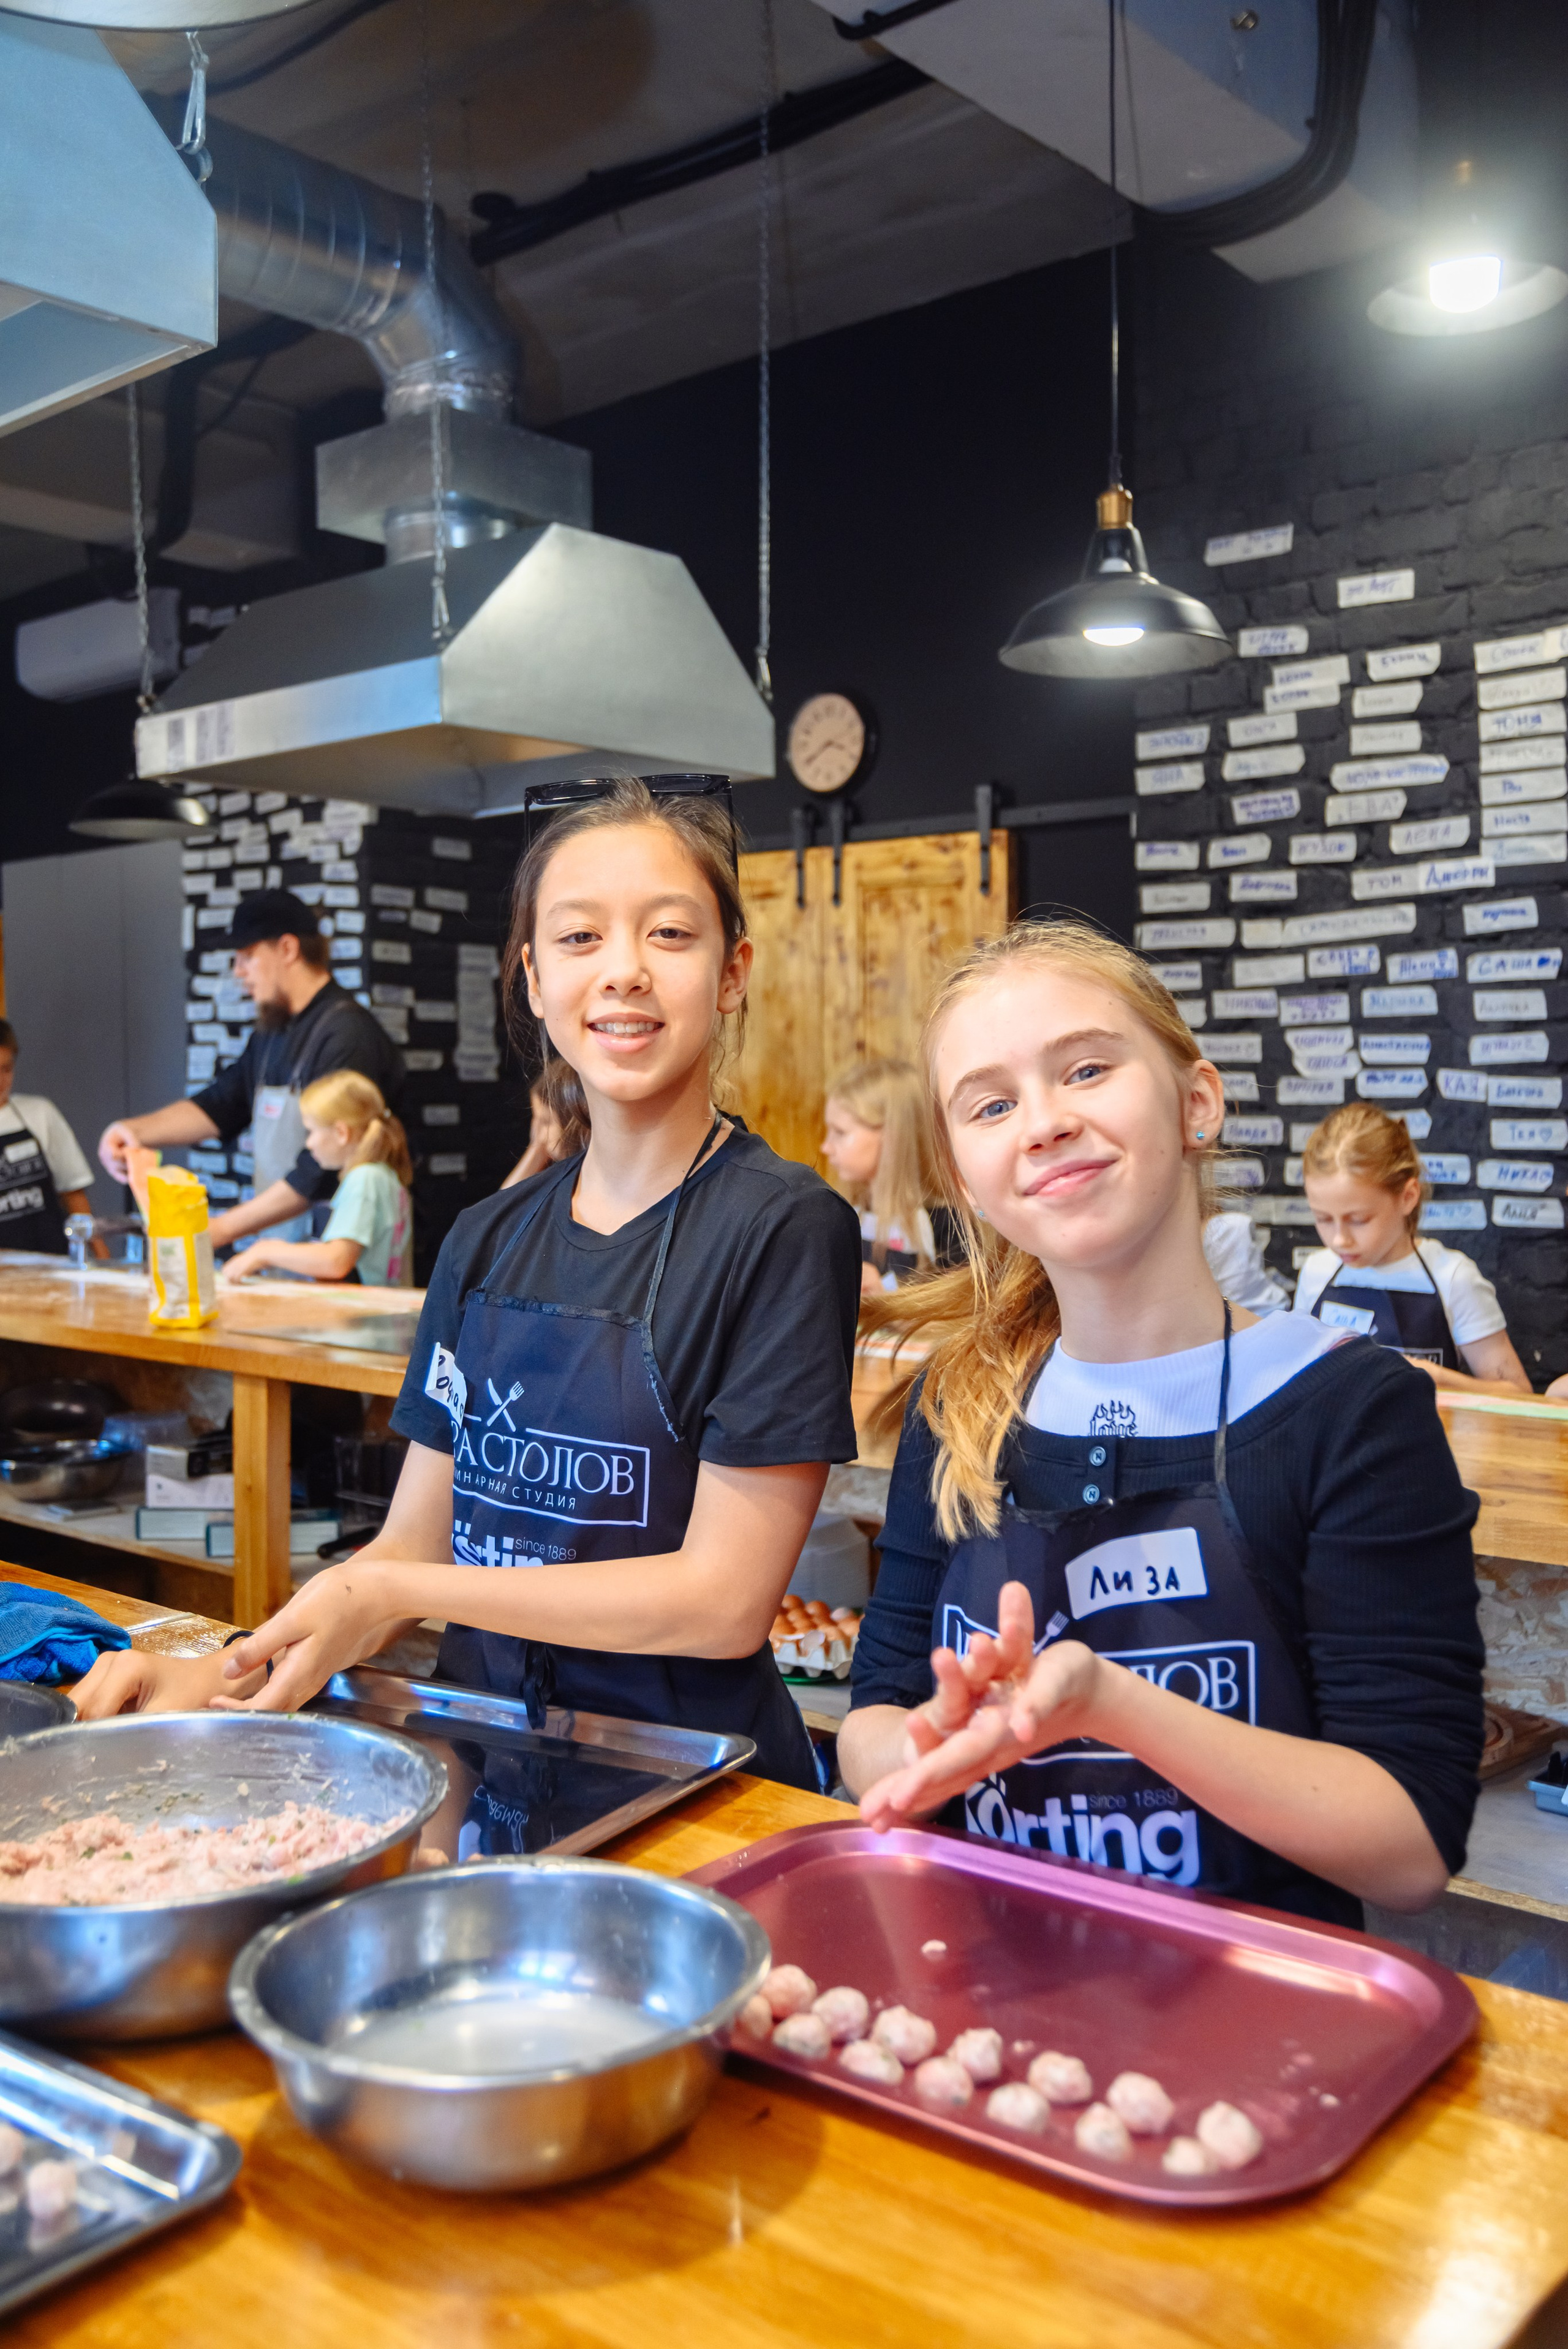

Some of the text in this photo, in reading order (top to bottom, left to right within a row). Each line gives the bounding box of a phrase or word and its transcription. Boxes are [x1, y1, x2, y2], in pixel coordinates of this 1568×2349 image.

[512, 1487, 576, 1510] СТУДИЯ
[514, 1537, 576, 1561] since 1889
[1089, 1788, 1178, 1809] since 1889
